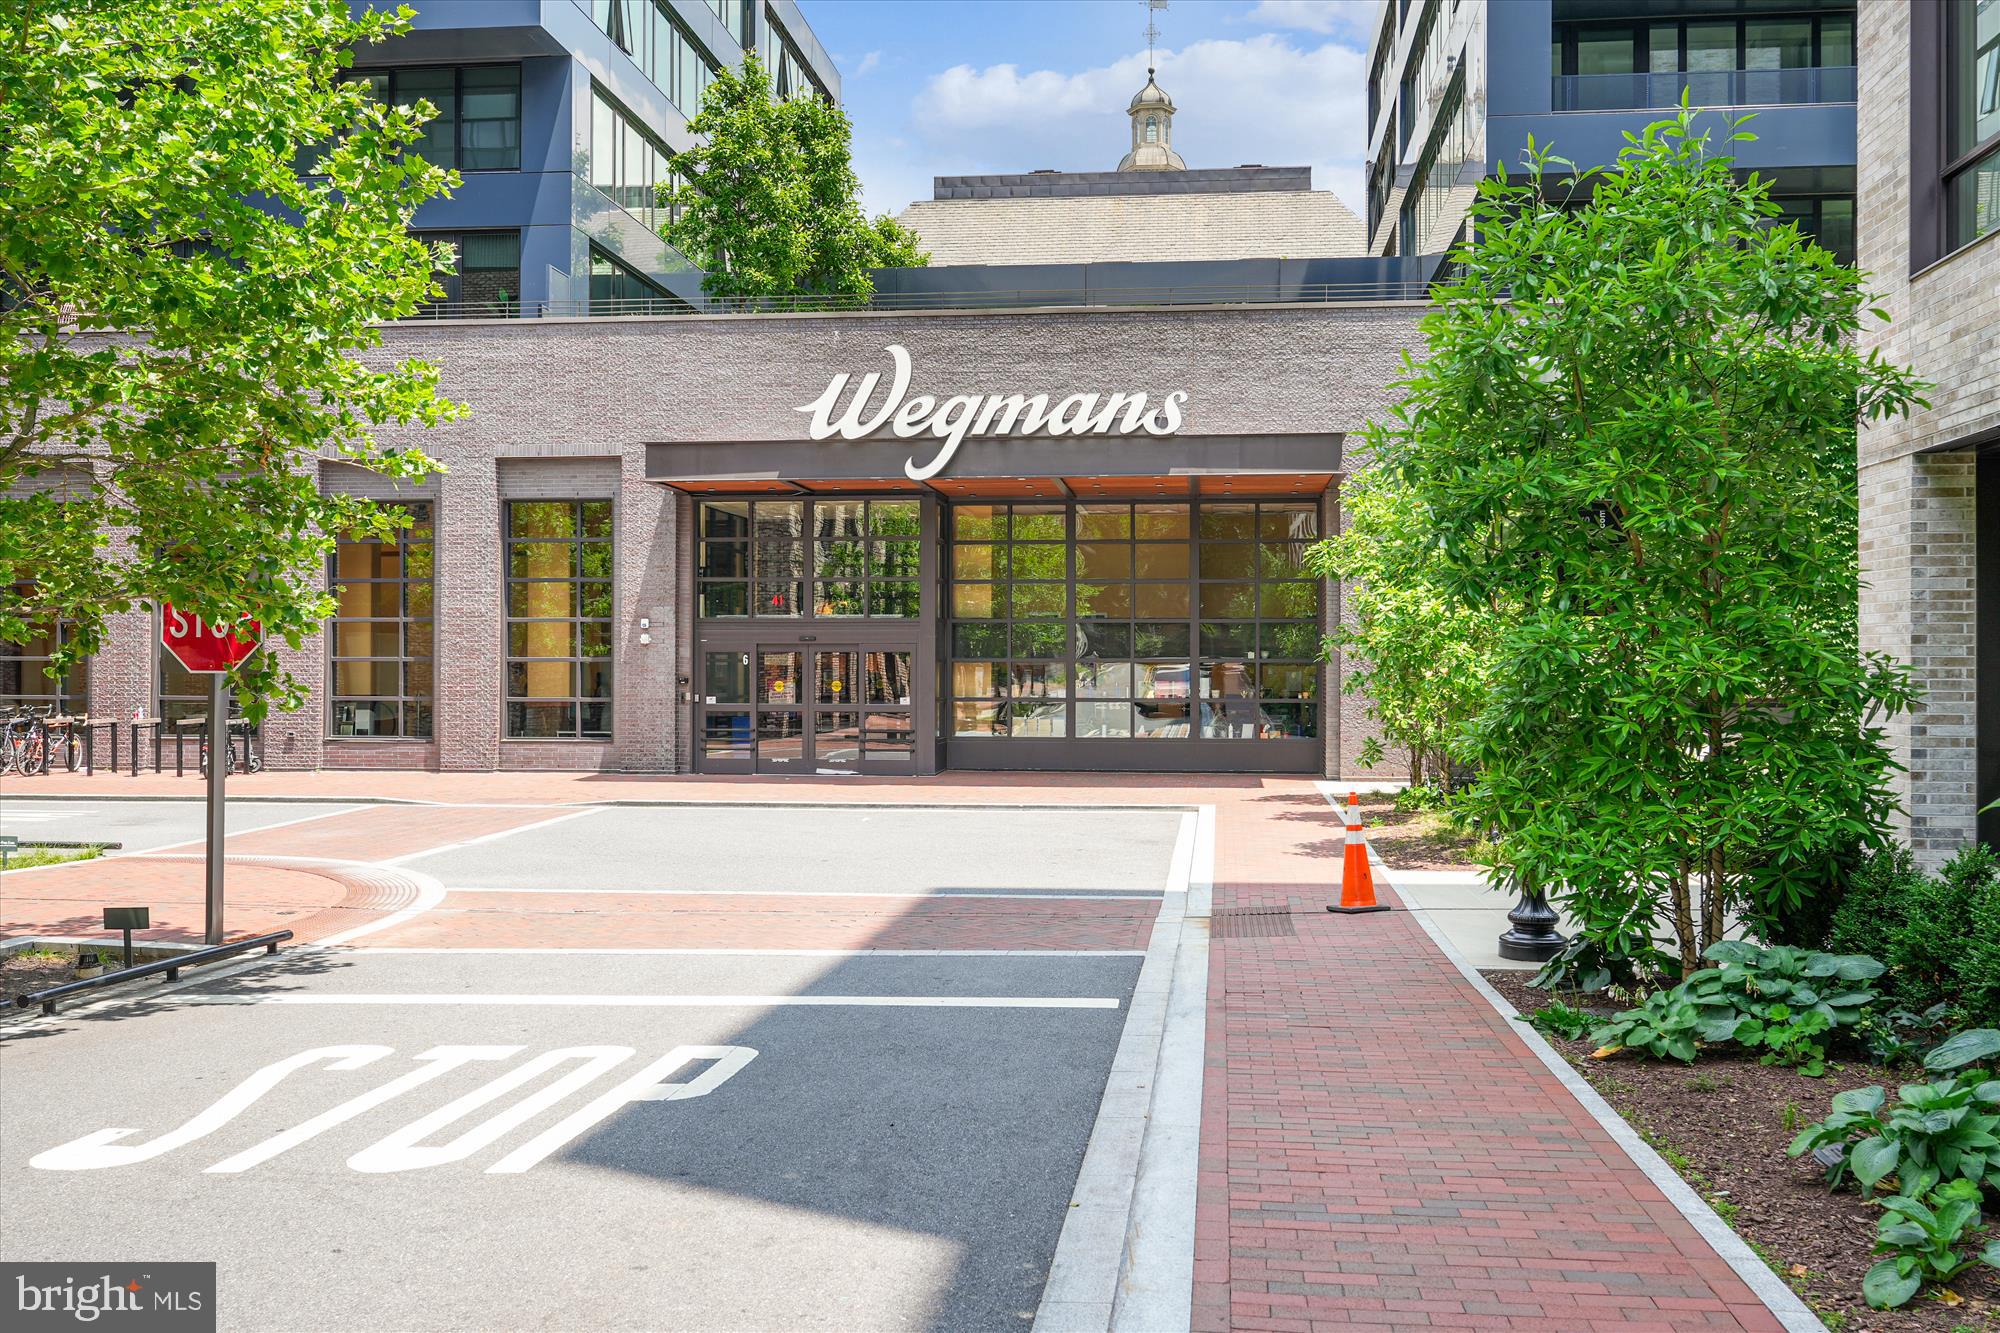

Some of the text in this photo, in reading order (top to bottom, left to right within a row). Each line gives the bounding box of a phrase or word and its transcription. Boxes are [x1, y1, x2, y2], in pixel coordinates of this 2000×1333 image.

[793, 344, 1188, 480] Wegmans
[169, 604, 253, 638] STO
[742, 654, 749, 665] 6
[29, 1045, 759, 1174] STOP
